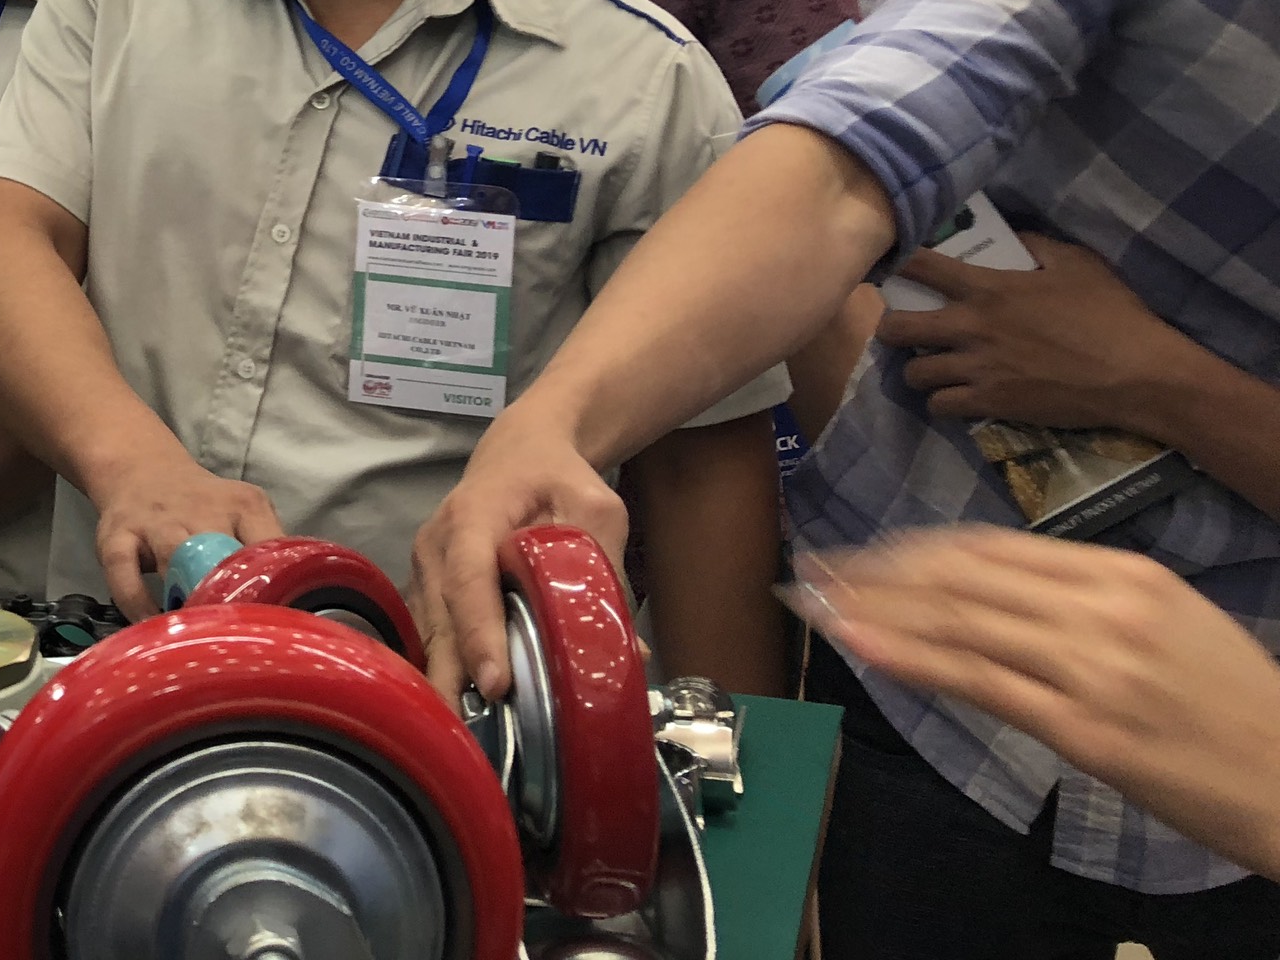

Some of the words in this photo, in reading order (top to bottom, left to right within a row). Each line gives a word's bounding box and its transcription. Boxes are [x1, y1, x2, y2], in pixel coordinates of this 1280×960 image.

[460, 117, 523, 141] Hitachi
[524, 126, 576, 151] Cable
[578, 136, 608, 157] VN
[369, 229, 411, 241] VIETNAM
[412, 233, 467, 247] INDUSTRIAL
[368, 240, 450, 256] MANUFACTURING
[451, 248, 473, 258] FAIR
[475, 250, 500, 260] 2019
[442, 392, 493, 408] VISITOR
